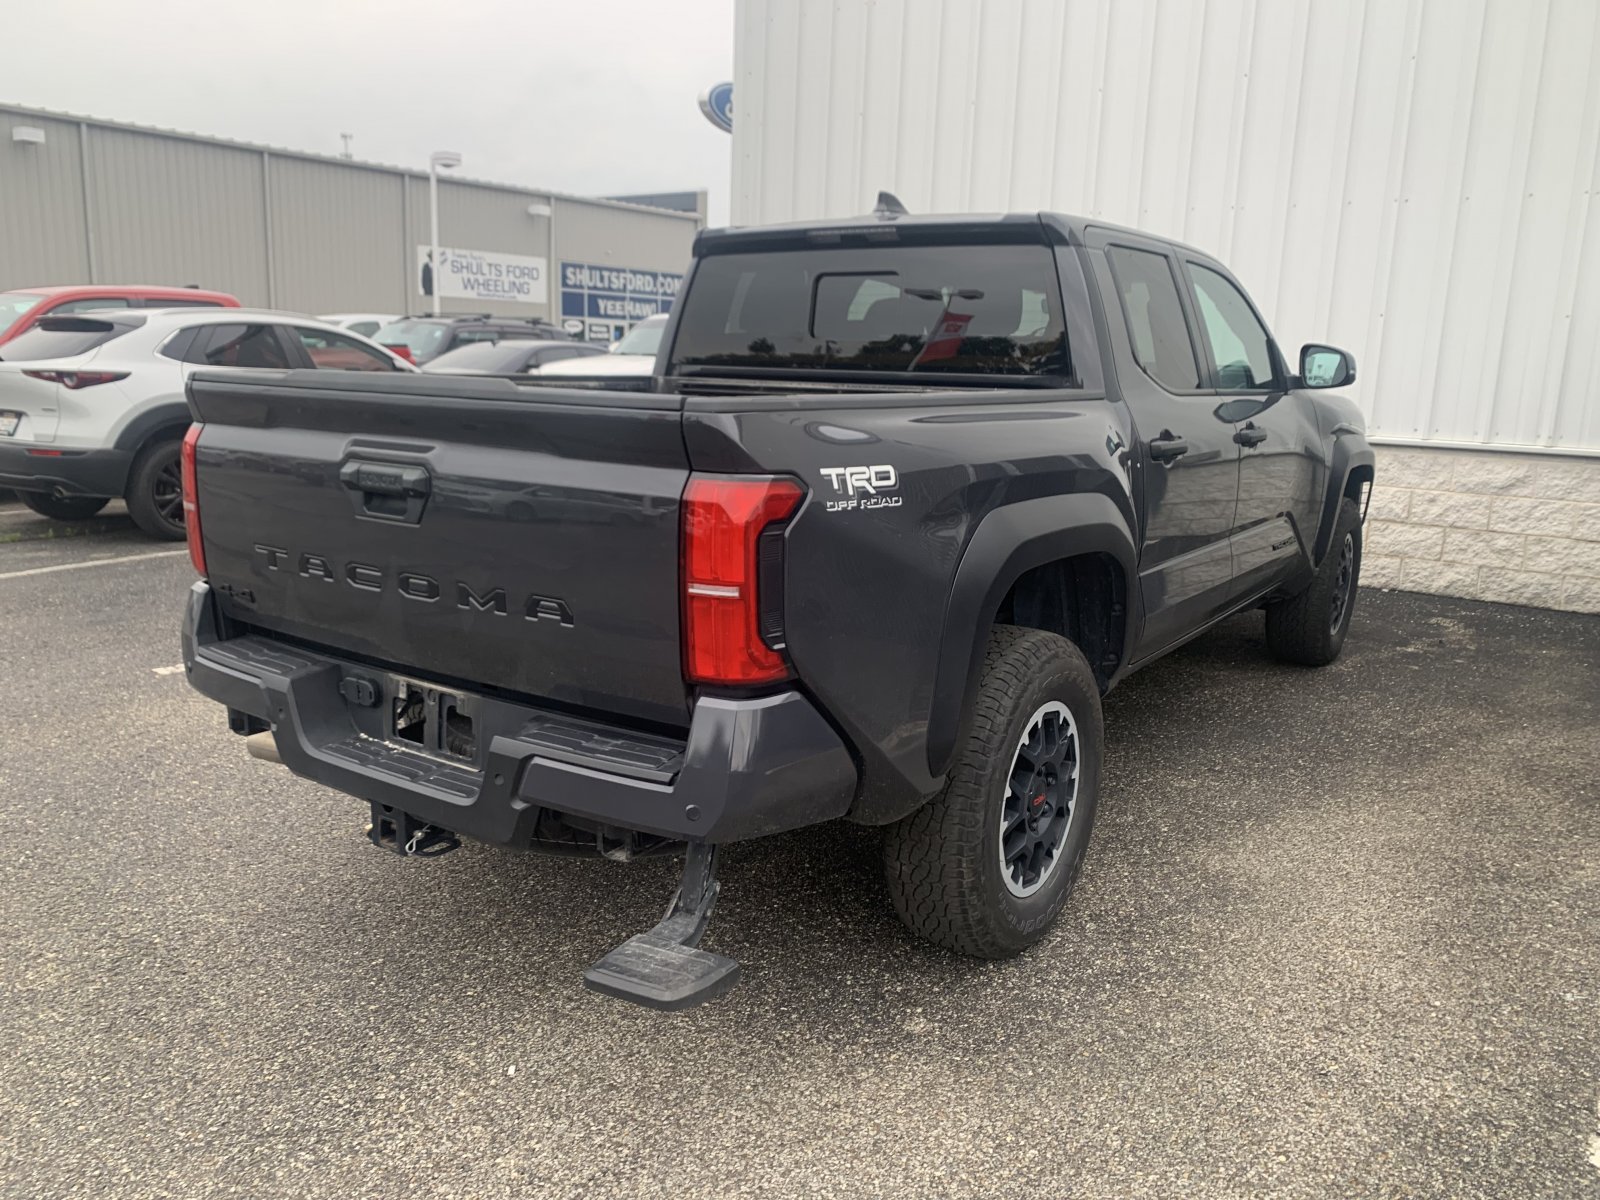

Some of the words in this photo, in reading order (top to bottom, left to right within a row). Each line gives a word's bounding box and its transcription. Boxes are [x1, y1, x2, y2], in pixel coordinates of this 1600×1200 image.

[451, 259, 503, 278] SHULTS
[506, 264, 540, 281] FORD
[461, 276, 530, 295] WHEELING
[820, 464, 898, 496] TRD
[826, 499, 857, 512] OFF
[860, 496, 903, 510] ROAD
[254, 544, 574, 627] TACOMA
